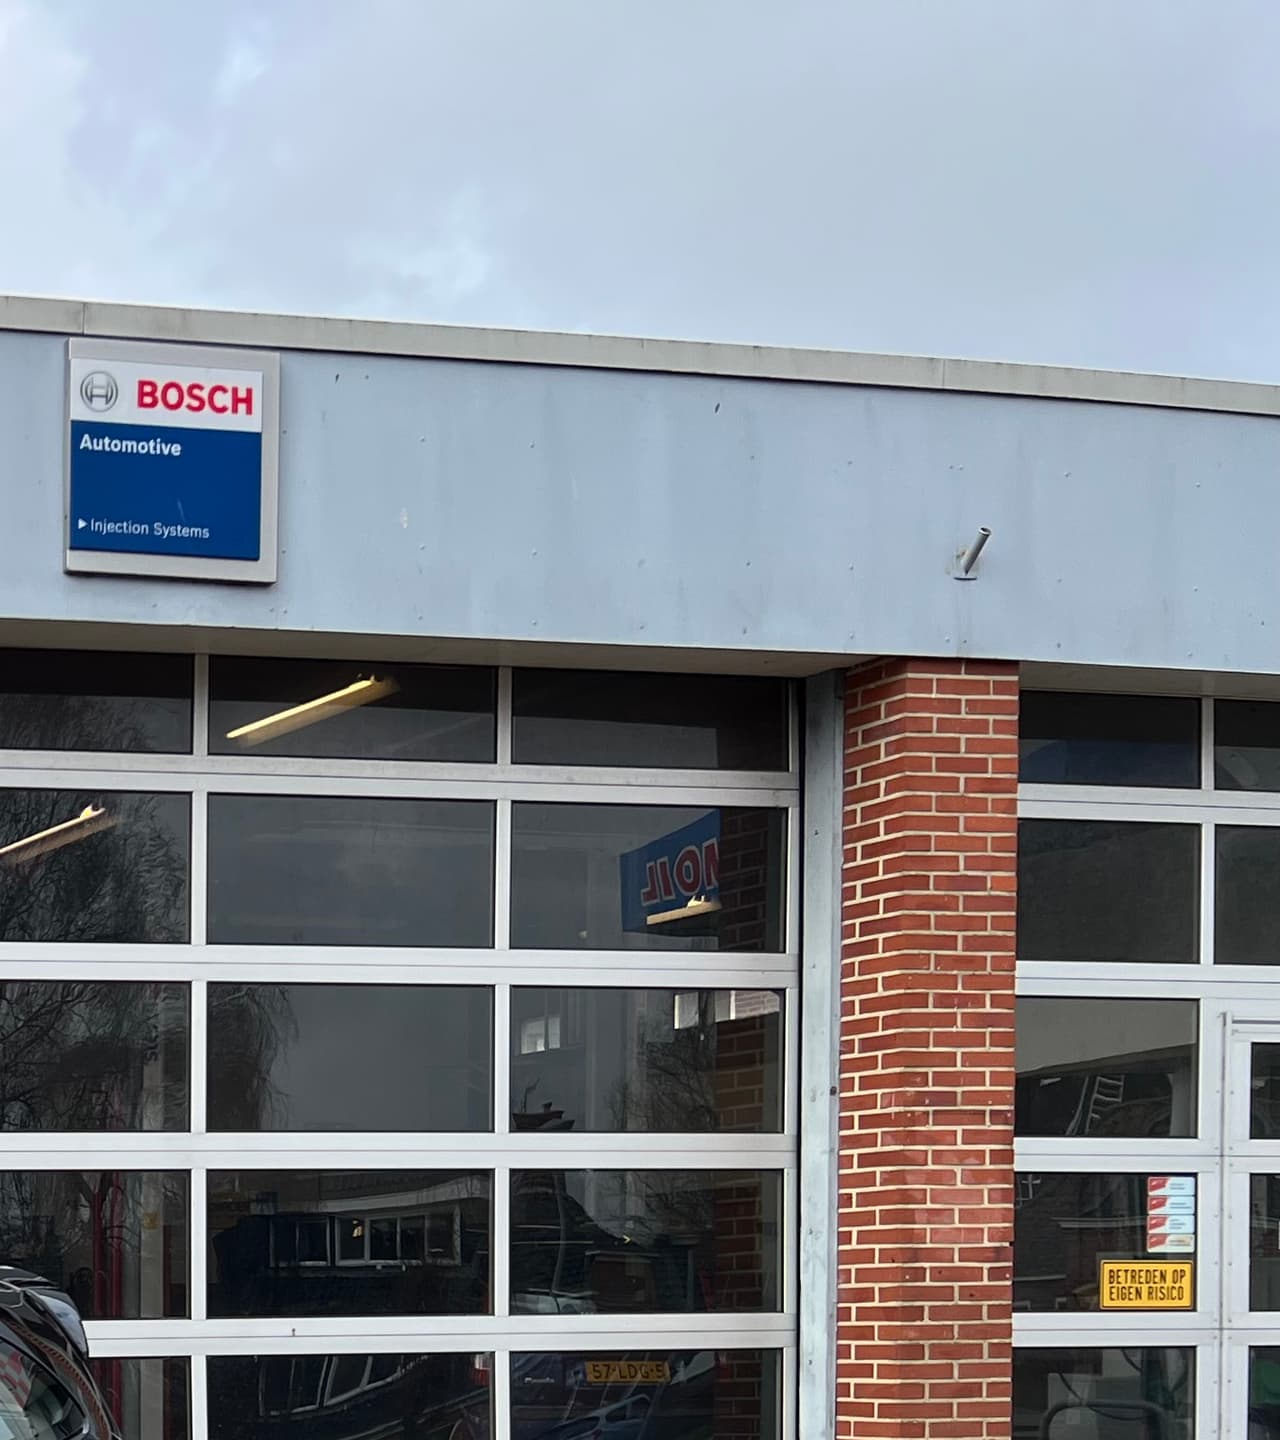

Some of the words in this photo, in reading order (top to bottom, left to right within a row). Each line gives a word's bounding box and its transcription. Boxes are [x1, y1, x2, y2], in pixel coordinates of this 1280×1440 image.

[137, 379, 254, 416] BOSCH
[80, 433, 182, 456] Automotive
[91, 518, 149, 535] Injection
[154, 522, 210, 539] Systems
[1108, 1269, 1167, 1285] BETREDEN
[1172, 1269, 1186, 1284] OP
[1109, 1285, 1143, 1301] EIGEN
[1148, 1285, 1184, 1301] RISICO
